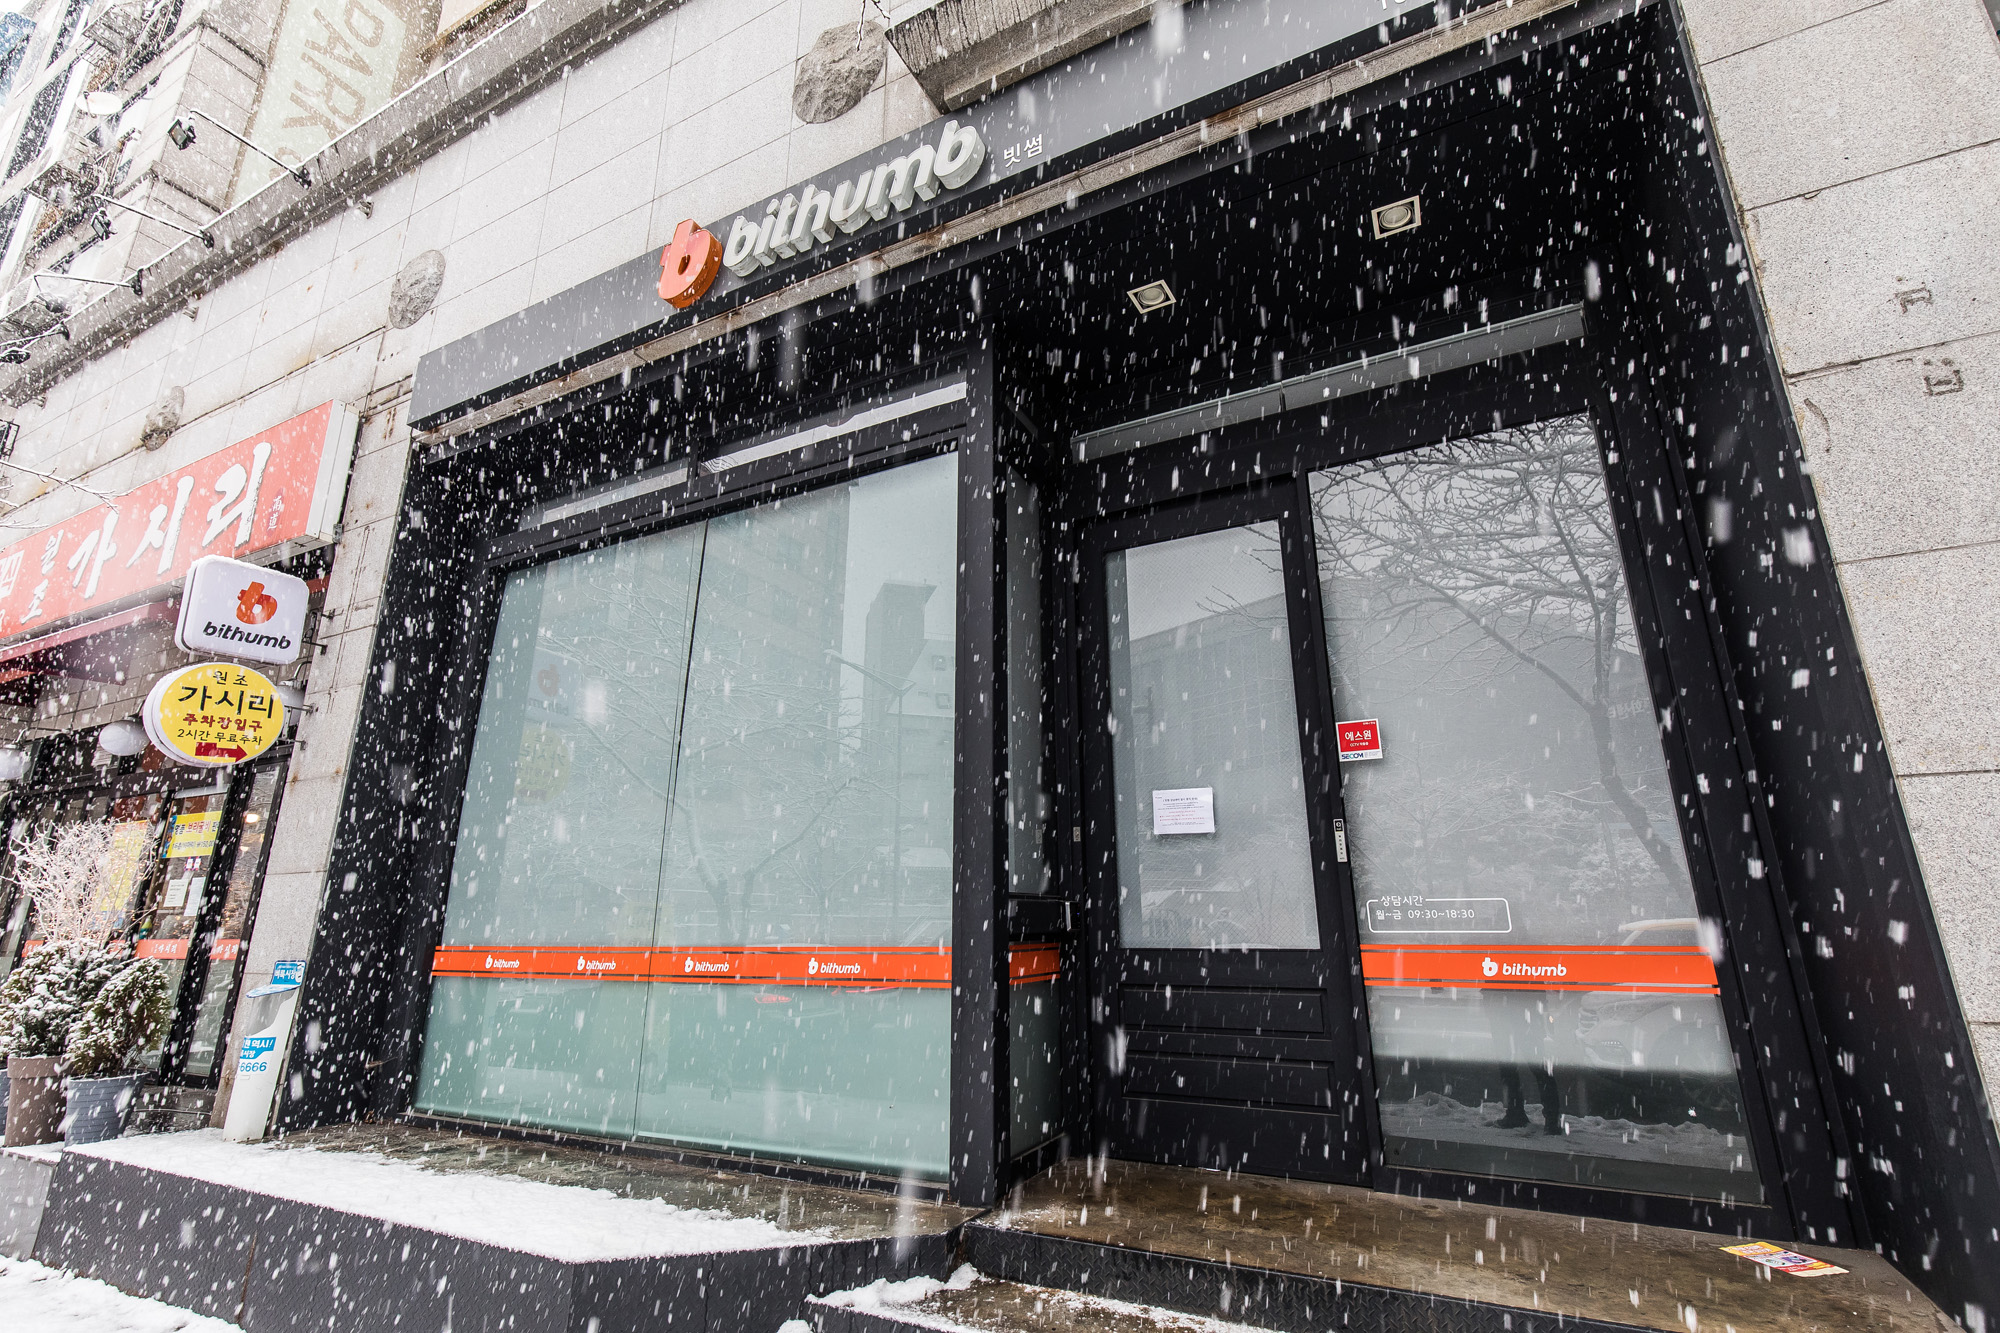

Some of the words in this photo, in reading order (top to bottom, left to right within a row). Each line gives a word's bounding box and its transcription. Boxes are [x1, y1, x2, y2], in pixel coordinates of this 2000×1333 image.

[1003, 133, 1043, 168] 빗썸
[723, 119, 985, 277] bithumb
[66, 442, 272, 600] 가시리
[203, 621, 291, 649] bithumb
[178, 685, 274, 719] 가시리
[177, 729, 211, 742] 2시간
[214, 732, 262, 745] 무료주차
[1344, 730, 1372, 741] 에스원
[1341, 752, 1364, 760] SECOM
[1380, 895, 1424, 907] 상담시간
[1375, 909, 1402, 920] 월~금
[1407, 909, 1475, 919] 09:30~18:30
[493, 959, 520, 969] bithumb
[586, 960, 617, 970] bithumb
[695, 961, 730, 972] bithumb
[820, 962, 861, 974] bithumb
[1502, 963, 1567, 977] bithumb
[251, 1038, 275, 1049] 역시!
